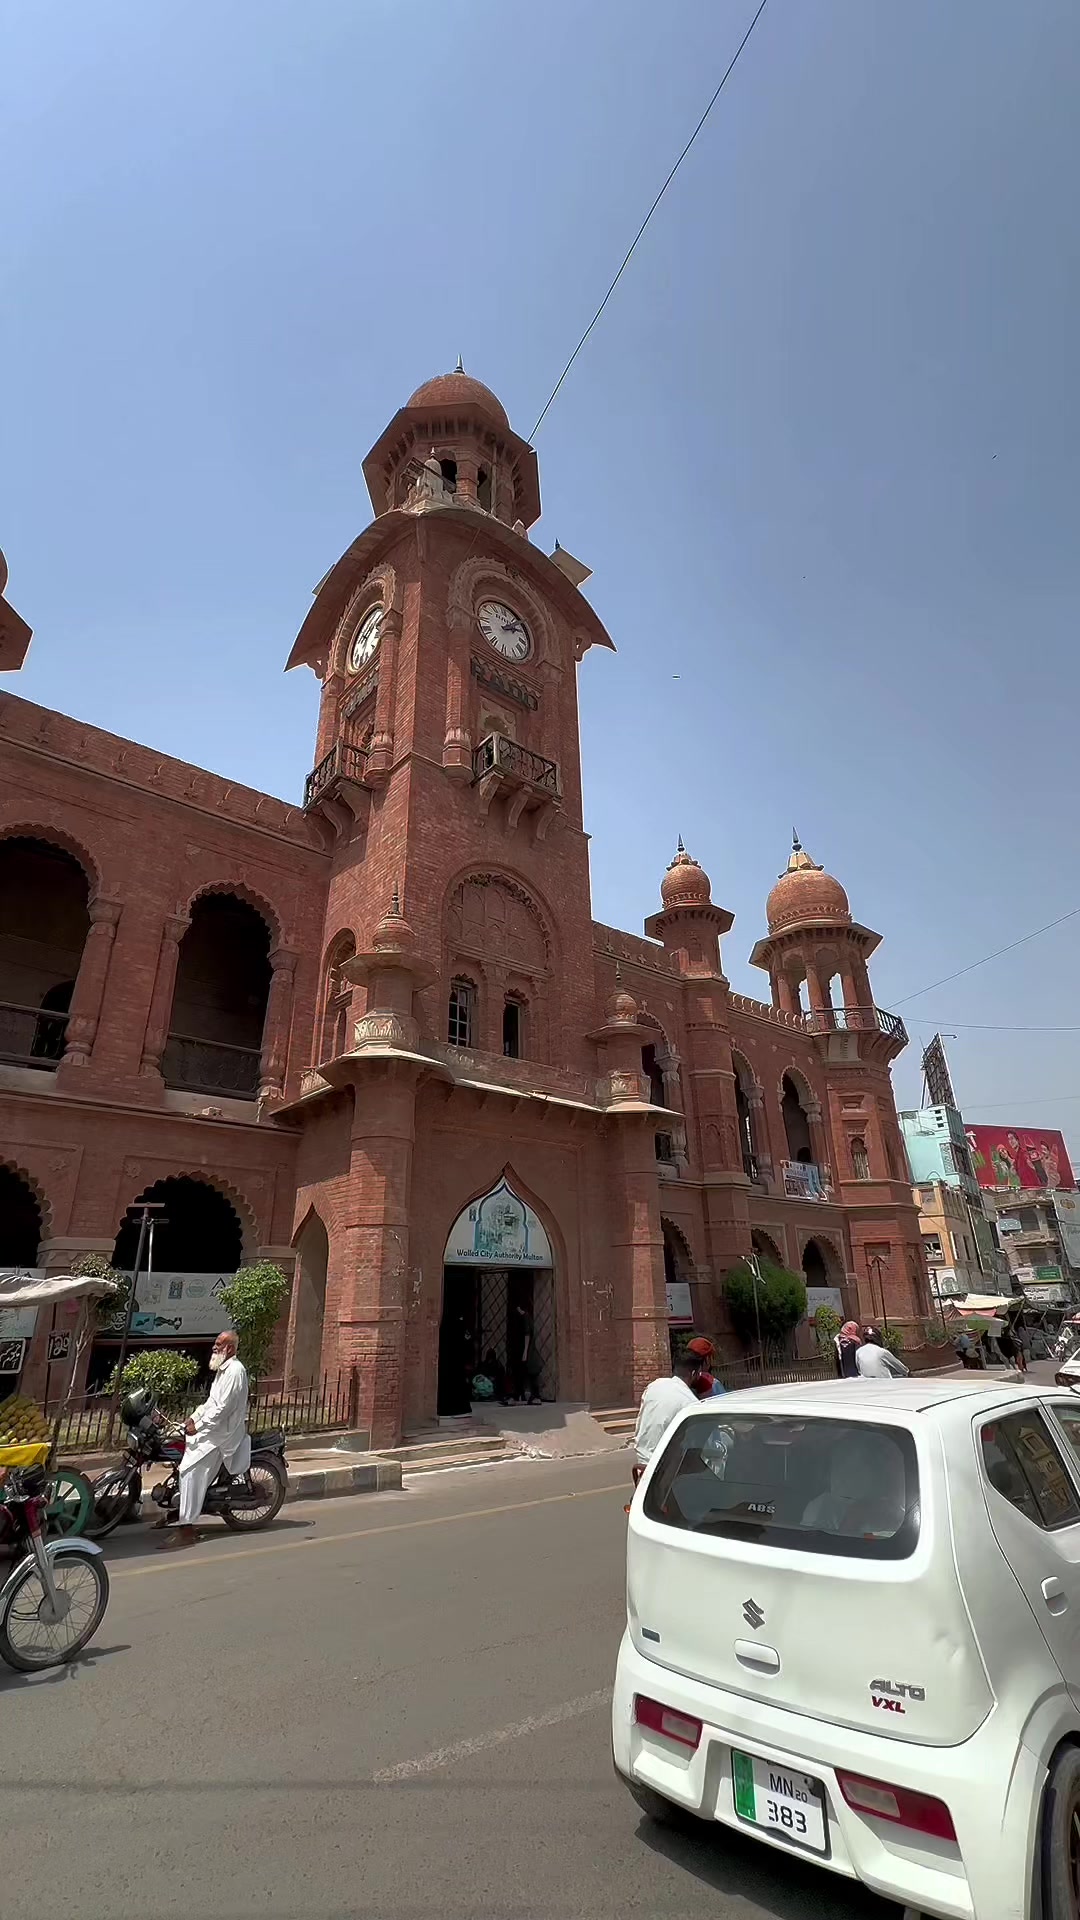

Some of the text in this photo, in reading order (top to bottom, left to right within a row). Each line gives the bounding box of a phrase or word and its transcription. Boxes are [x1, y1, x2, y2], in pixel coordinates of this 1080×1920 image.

[456, 1248, 544, 1261] Walled City Authority Multan
[747, 1503, 776, 1514] ABS
[869, 1678, 926, 1702] ALTO
[871, 1695, 906, 1714] VXL
[769, 1772, 808, 1803] MN 20
[766, 1799, 807, 1834] 383
